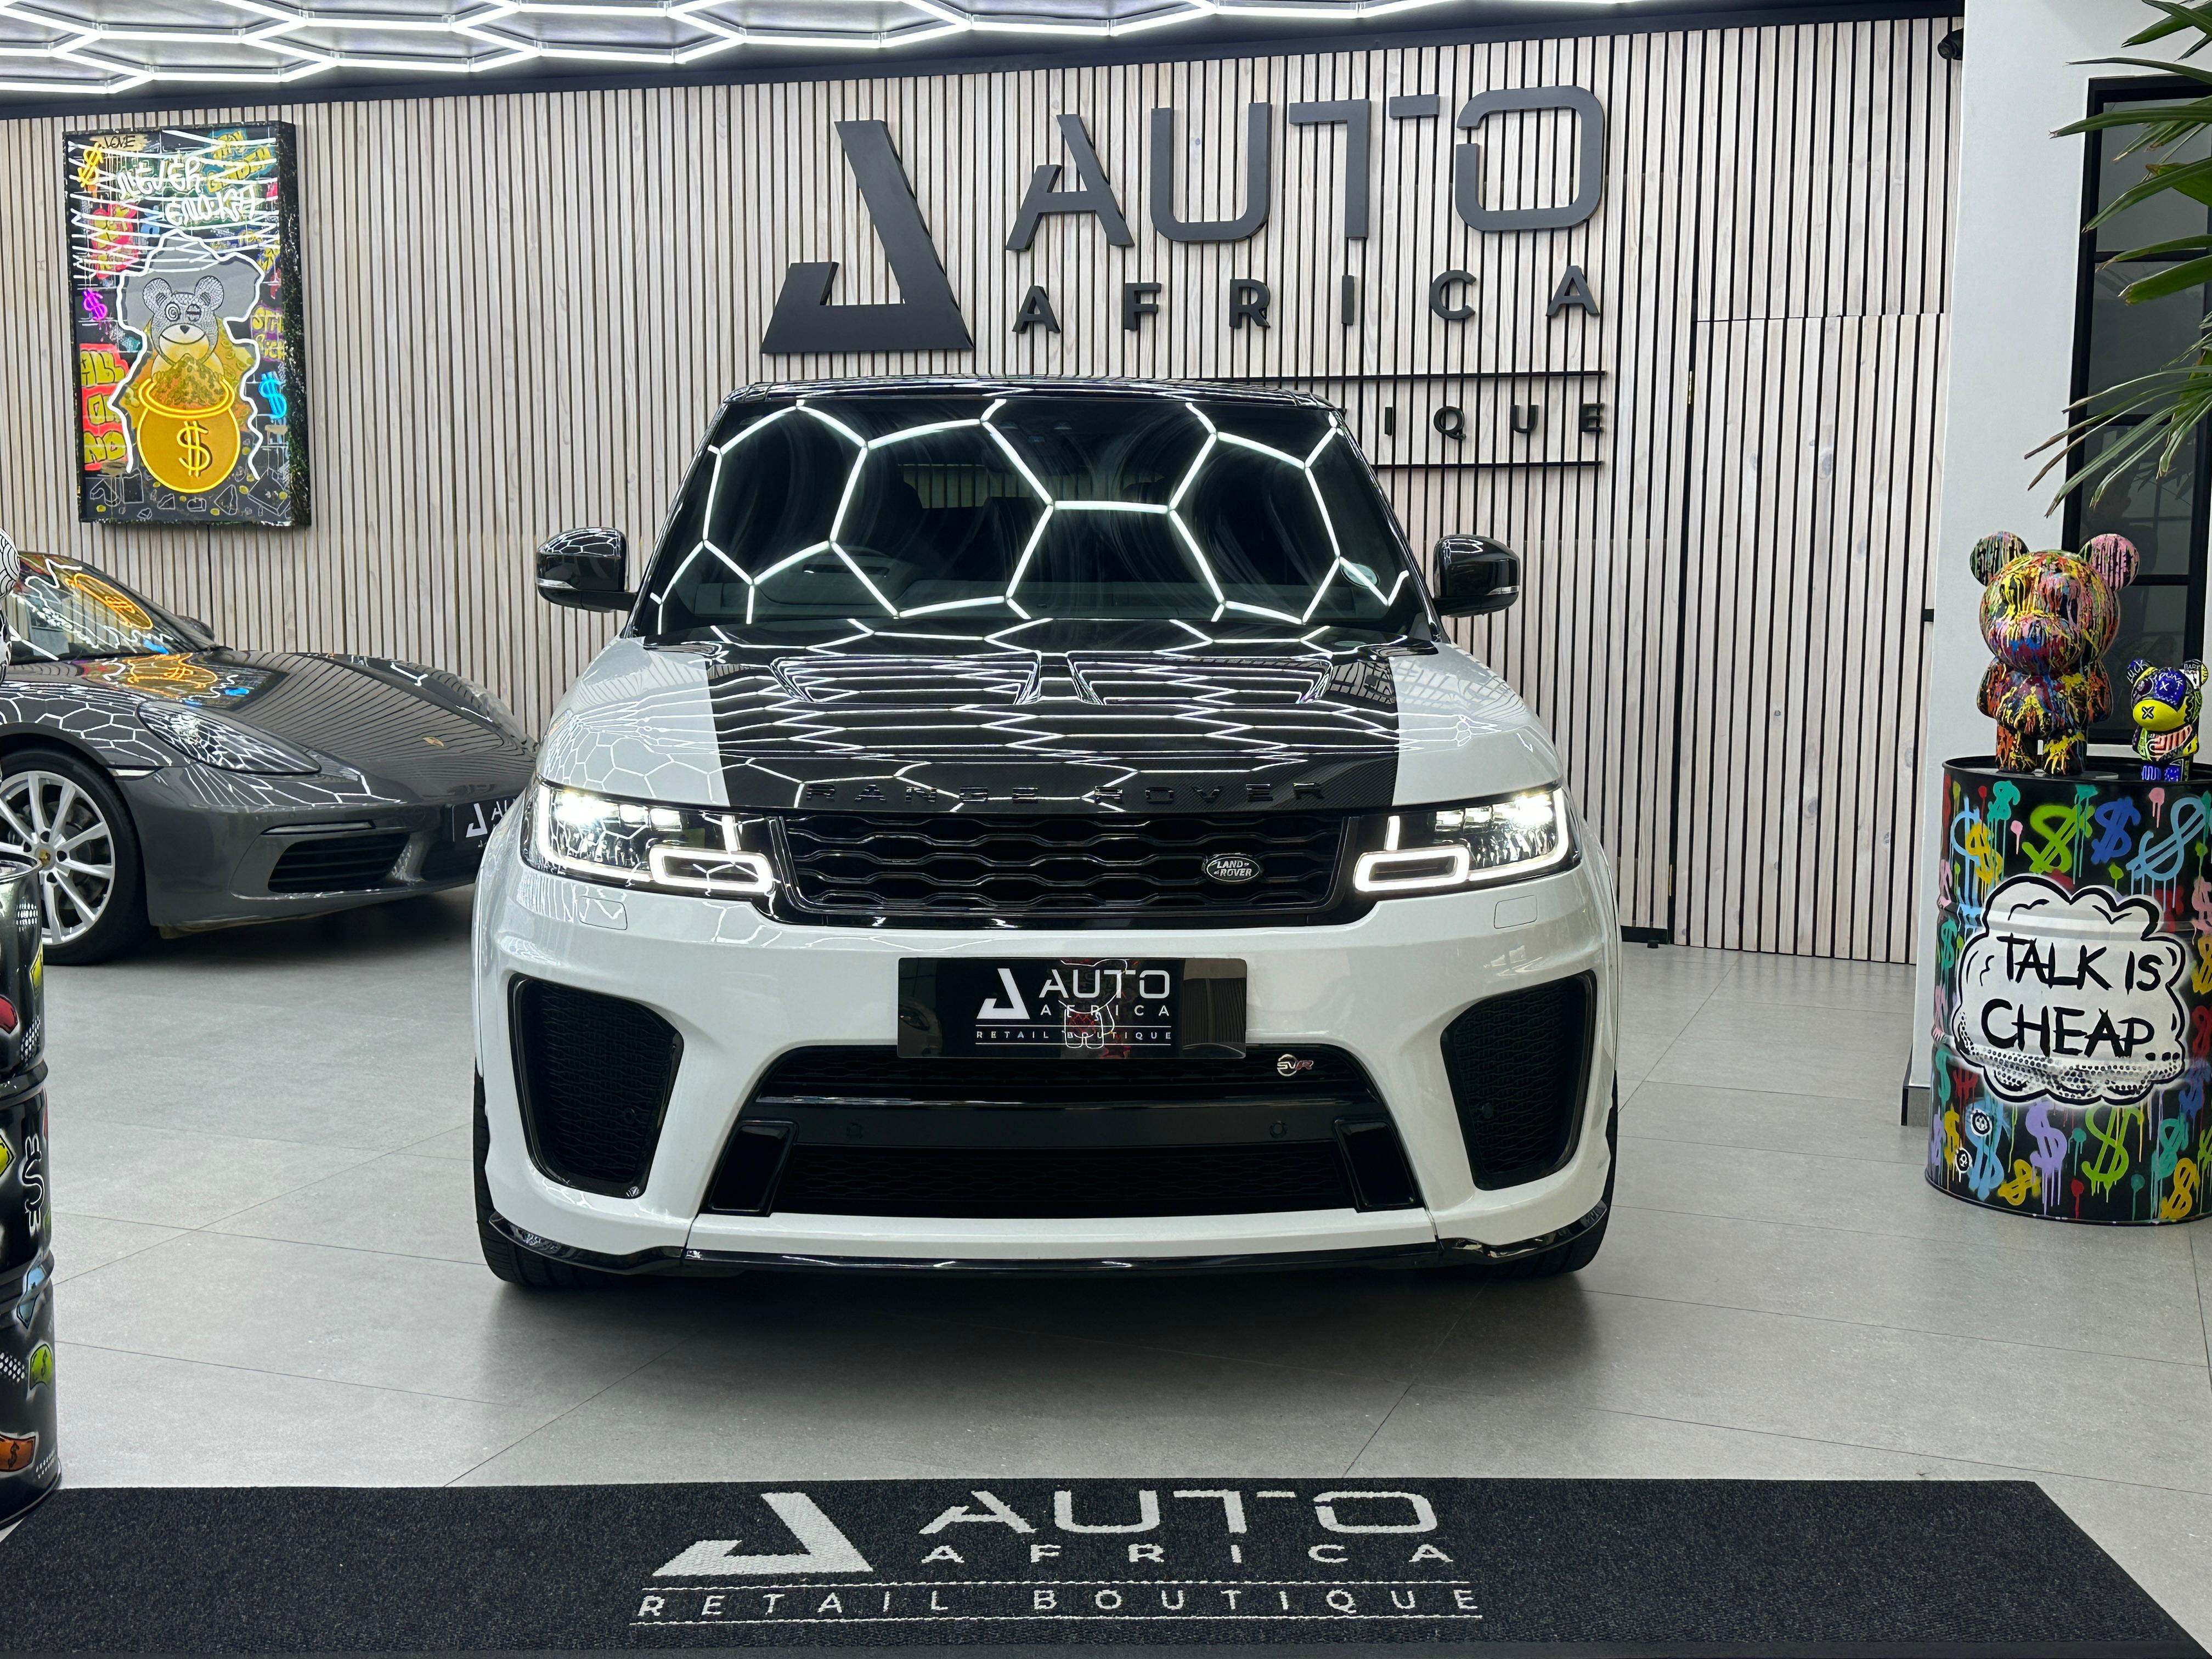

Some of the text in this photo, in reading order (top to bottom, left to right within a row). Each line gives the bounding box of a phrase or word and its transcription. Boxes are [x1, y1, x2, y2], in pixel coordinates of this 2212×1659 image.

[104, 135, 136, 148] LOVE
[117, 156, 203, 200] NEVER
[1006, 84, 1606, 251] AUTO
[1012, 265, 1601, 332] AFRICA
[81, 349, 126, 387] ALL
[1341, 403, 1605, 439] IQUE
[806, 782, 1324, 804] RANGE ROVER
[1217, 860, 1243, 868] LAND
[1220, 868, 1252, 877] ROVER
[1997, 933, 2164, 994] TALK IS
[1039, 969, 1170, 998] AUTO
[1040, 1005, 1170, 1018] AFRICA
[919, 1489, 1437, 1534] AUTO
[922, 1544, 1453, 1564] AFRICA
[637, 1589, 1478, 1616] RETAIL BOUTIQUE
